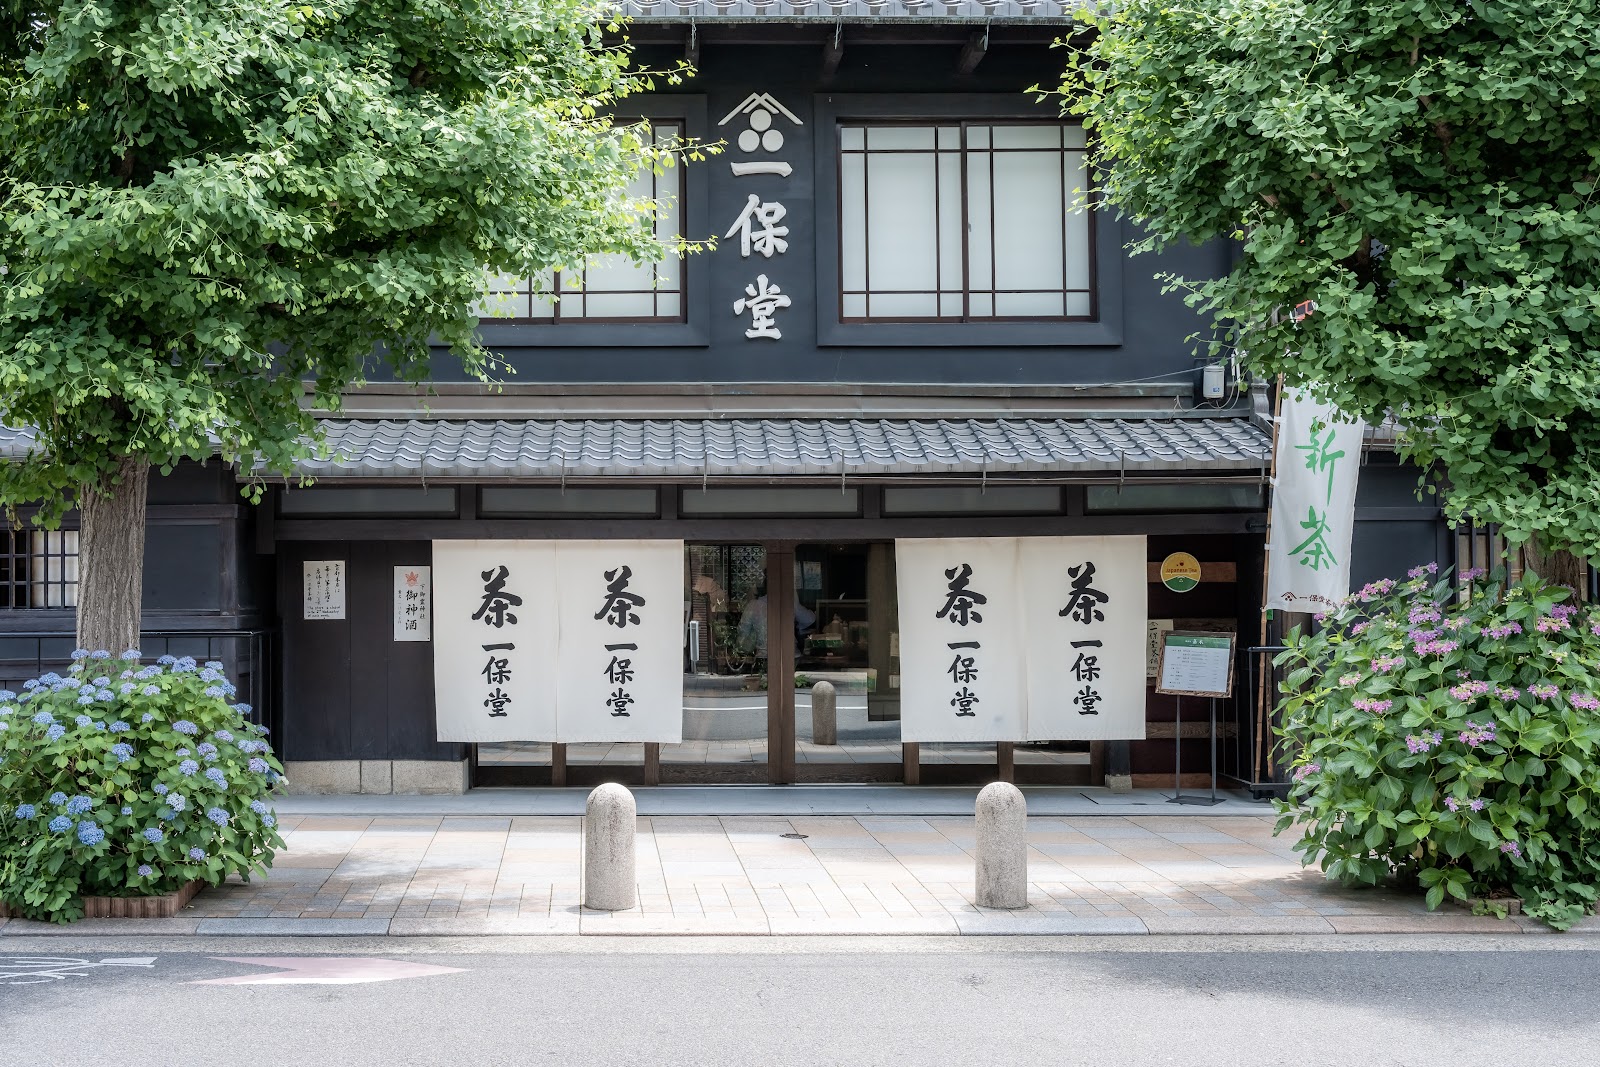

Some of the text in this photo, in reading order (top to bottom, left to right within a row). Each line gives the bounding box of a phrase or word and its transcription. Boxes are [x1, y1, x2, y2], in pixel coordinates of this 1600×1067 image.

[724, 161, 793, 340] 一保堂
[1288, 416, 1345, 572] 新茶
[405, 589, 418, 631] 御神酒
